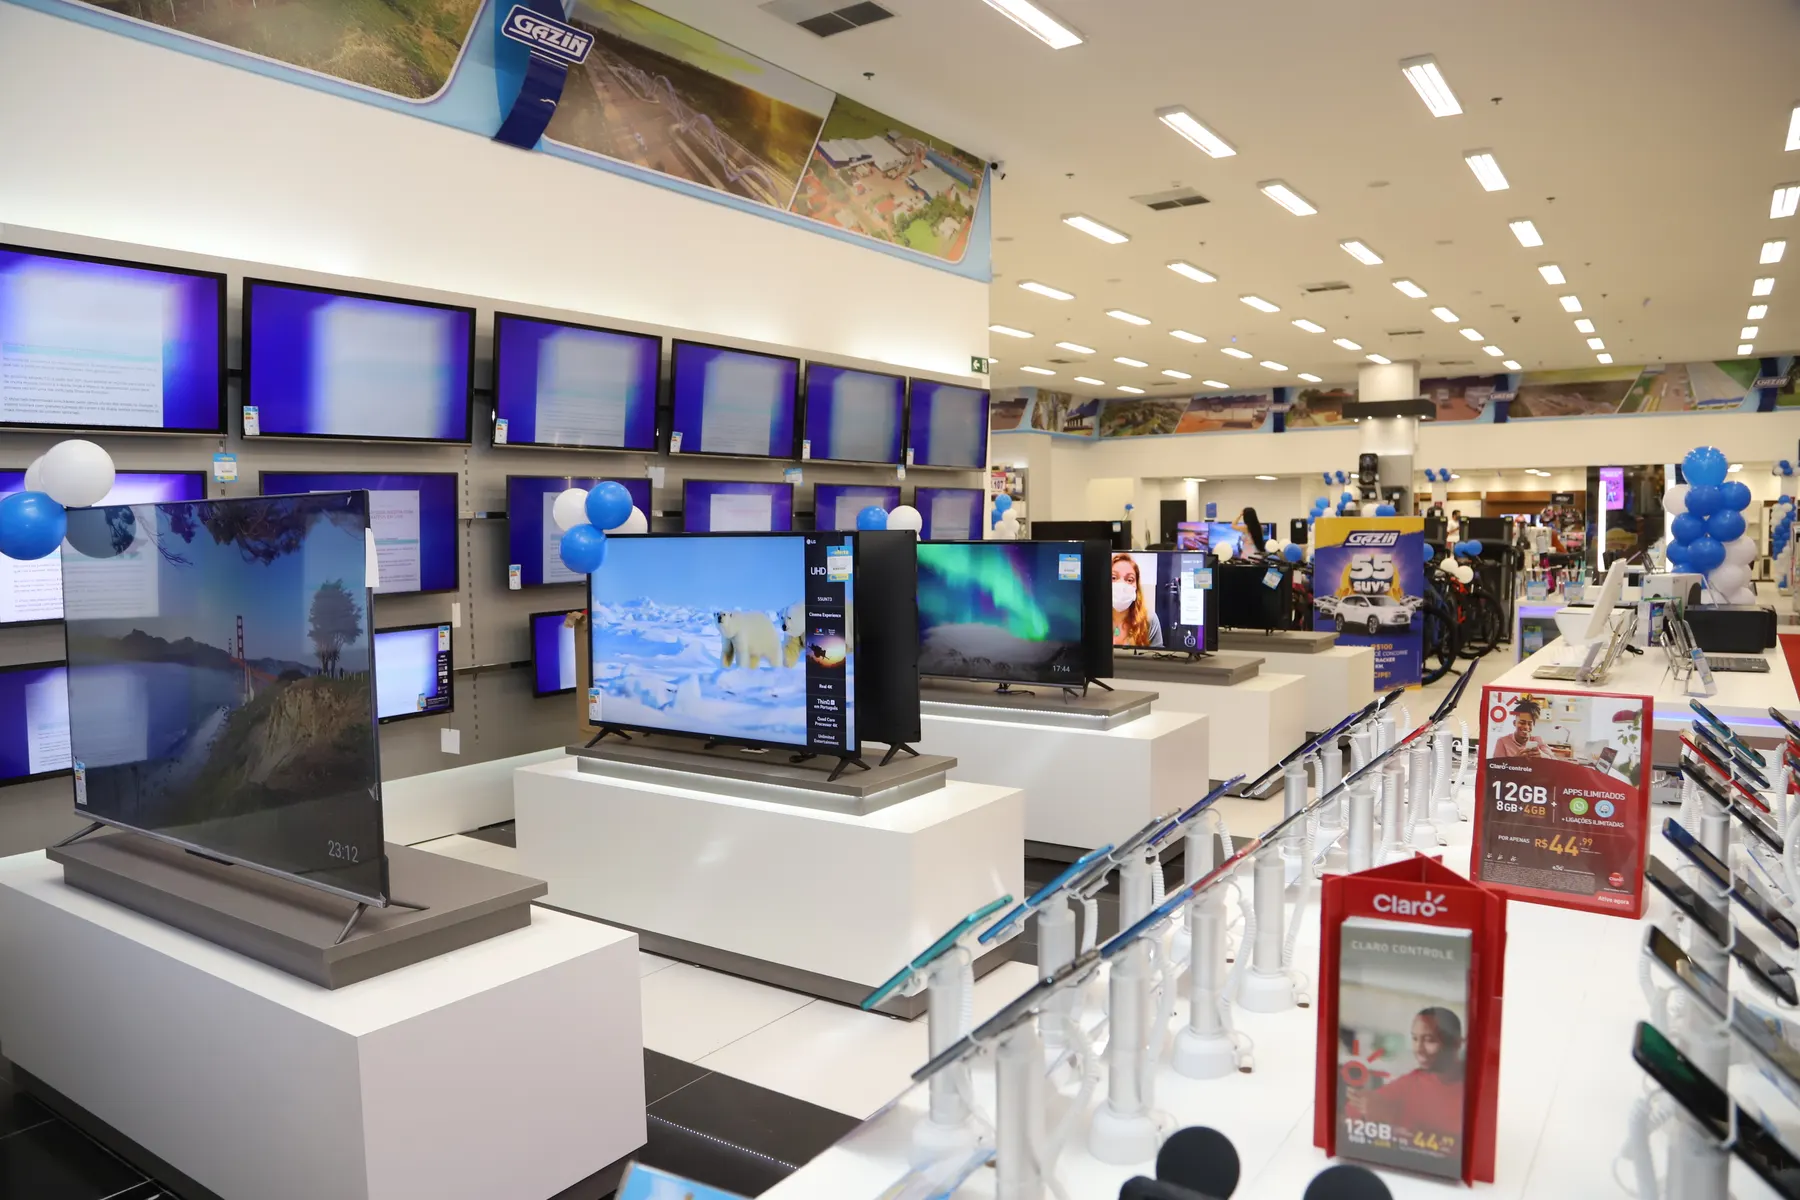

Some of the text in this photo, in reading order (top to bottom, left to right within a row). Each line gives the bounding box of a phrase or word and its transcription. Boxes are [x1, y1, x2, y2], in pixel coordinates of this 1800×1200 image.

[1345, 532, 1399, 546] GAZIN
[810, 567, 826, 575] UHD
[1349, 553, 1394, 580] 55
[1052, 665, 1071, 673] 17:44
[1491, 780, 1548, 804] 12GB
[1562, 787, 1626, 801] APPS ILIMITADOS
[1592, 819, 1625, 829] ILIMITADAS
[1509, 836, 1530, 844] APENAS
[328, 840, 359, 864] 23:12
[1373, 890, 1437, 917] Claro
[1351, 940, 1454, 960] CLARO CONTROLE
[1345, 1118, 1392, 1140] 12GB
